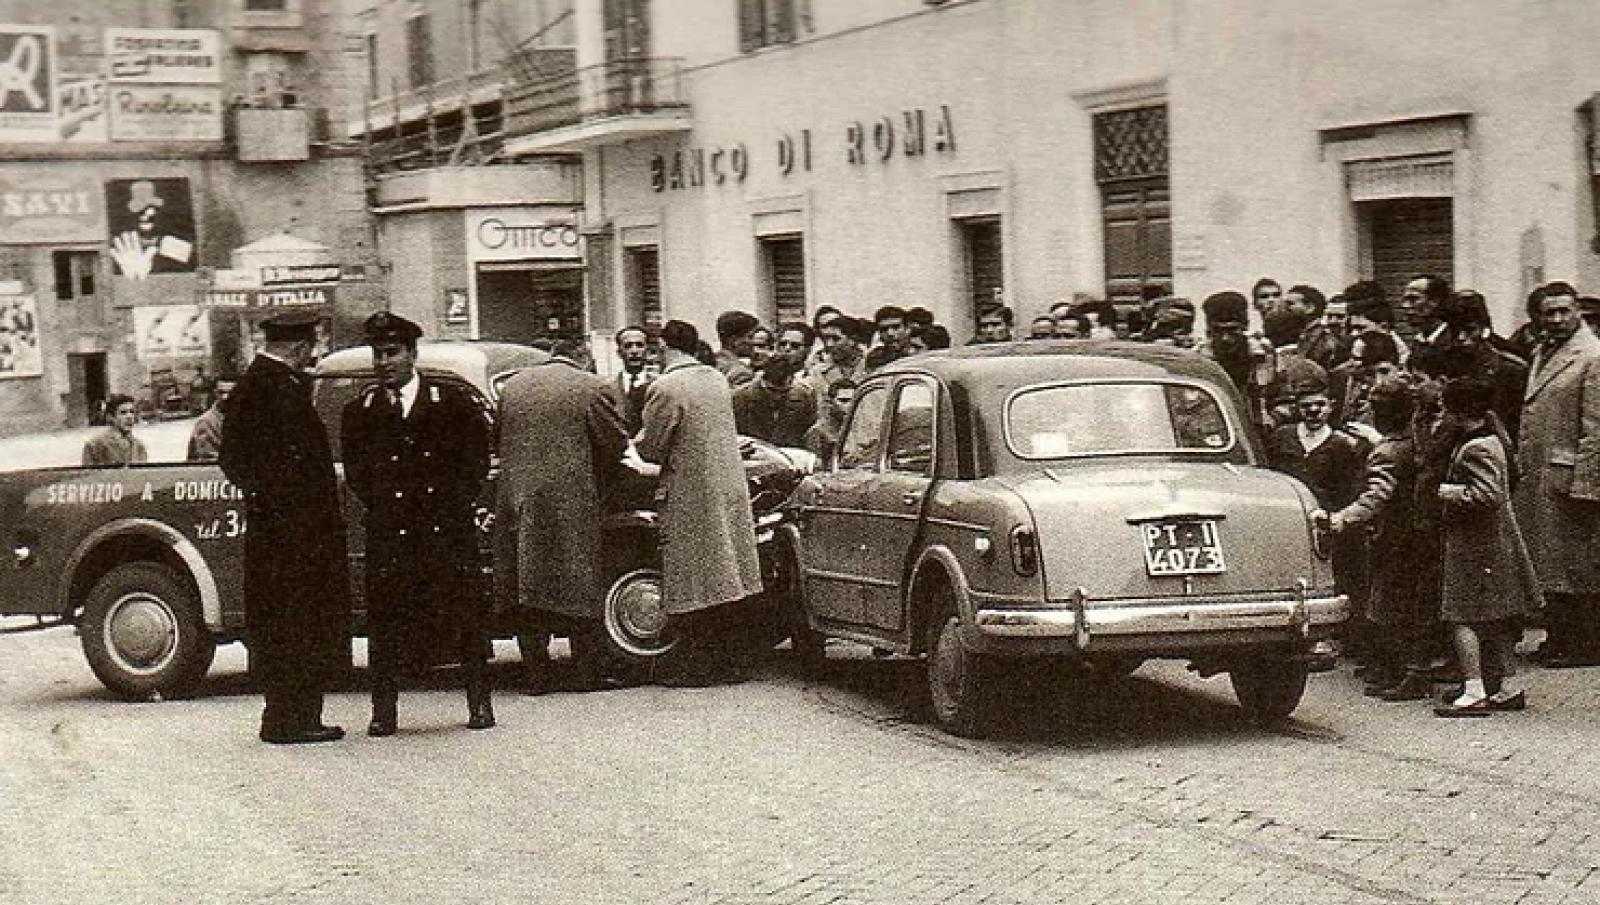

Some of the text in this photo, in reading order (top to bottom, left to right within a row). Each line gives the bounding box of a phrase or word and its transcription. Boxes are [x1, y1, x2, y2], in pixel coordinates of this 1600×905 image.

[651, 105, 957, 192] BANCO DI ROMA
[3, 193, 91, 216] SAVI
[47, 483, 123, 503] SERVIZIO
[141, 482, 153, 501] A
[1149, 547, 1220, 572] 4073
